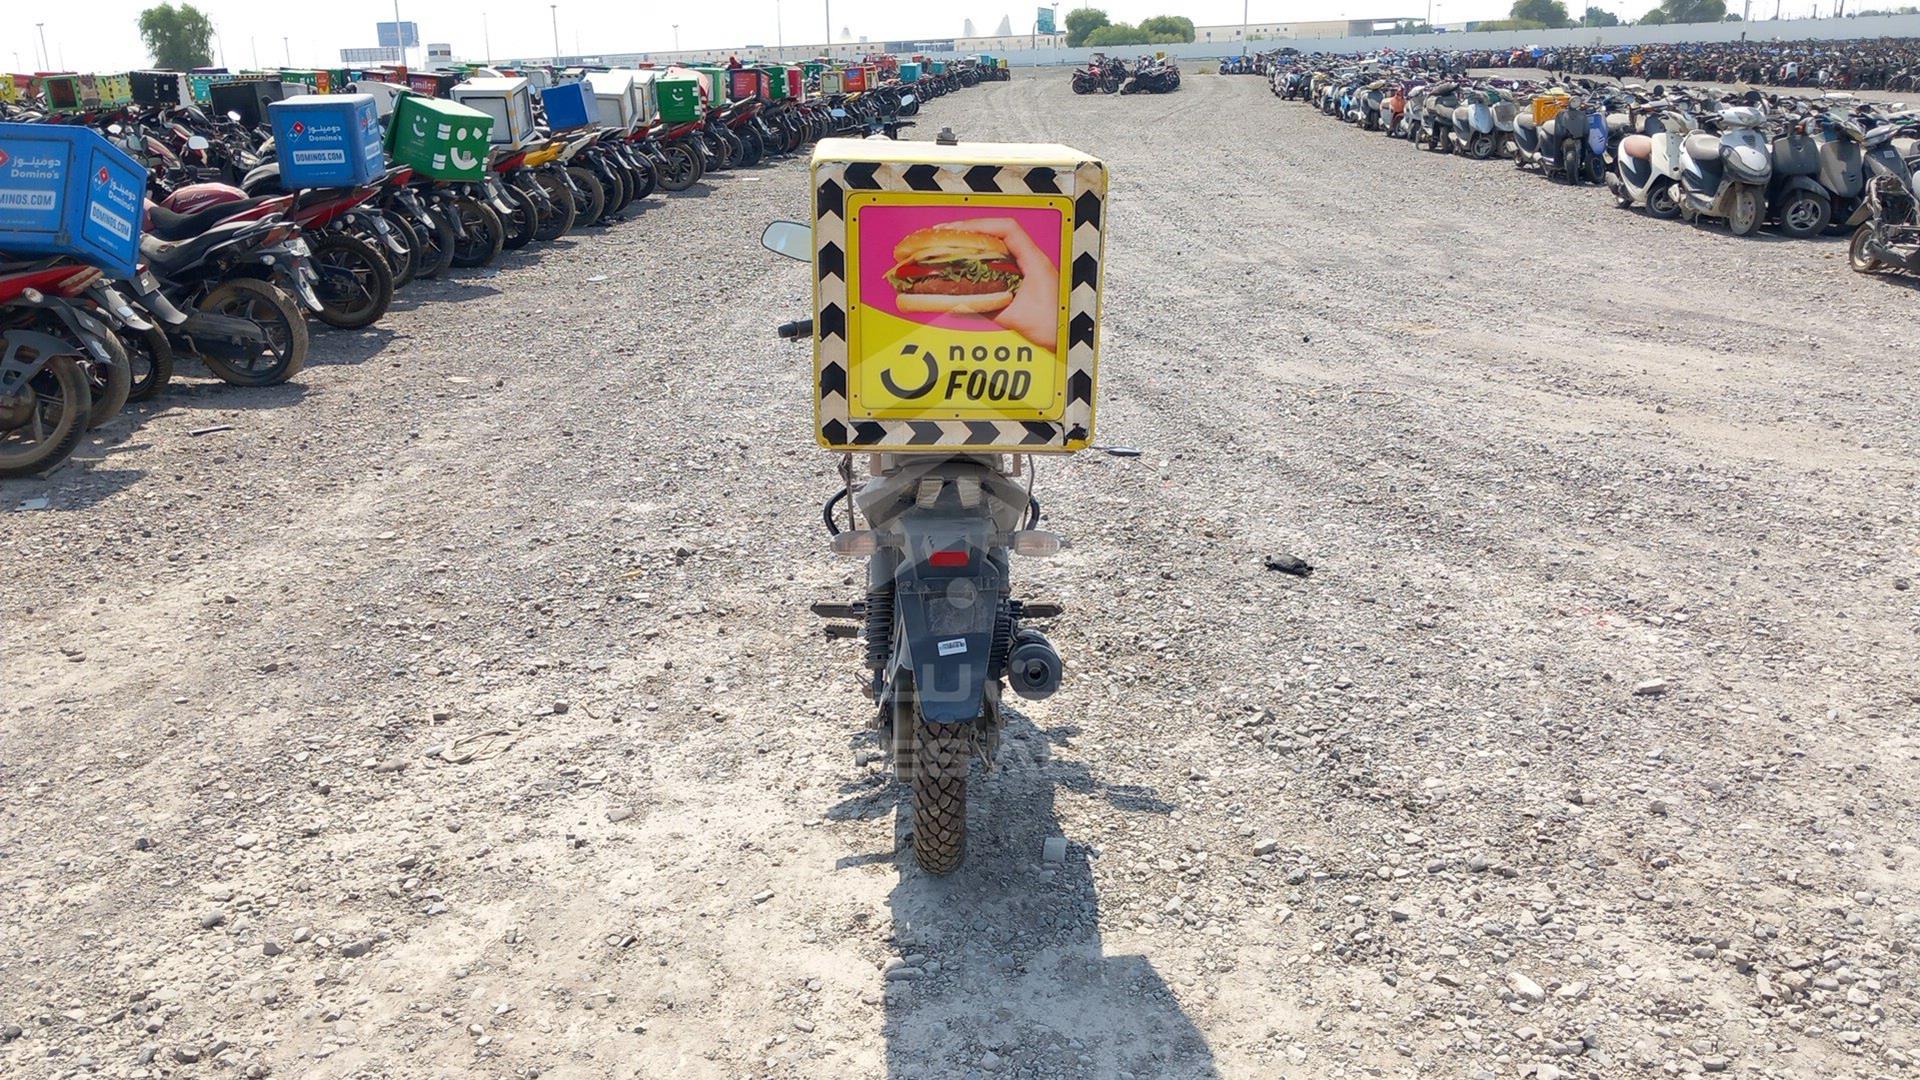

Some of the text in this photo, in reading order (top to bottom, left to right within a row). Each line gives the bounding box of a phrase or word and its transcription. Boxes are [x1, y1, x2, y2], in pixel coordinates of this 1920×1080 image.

[295, 152, 343, 162] DOMINOS.COM
[11, 169, 60, 179] Domino's
[948, 345, 1034, 362] noon
[944, 369, 1032, 401] FOOD
